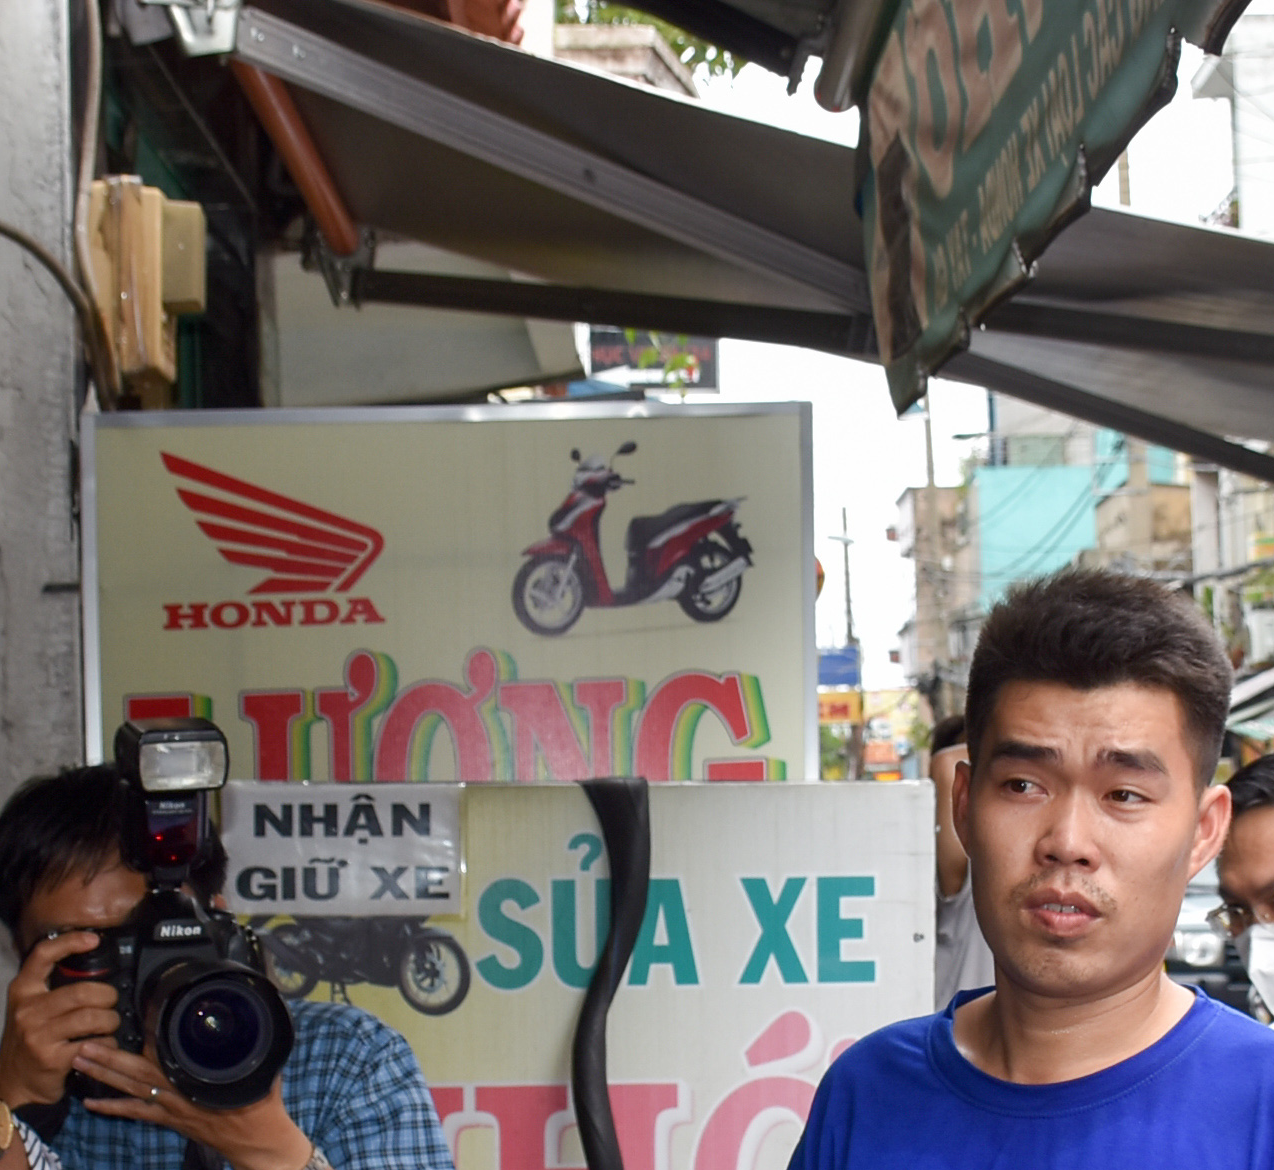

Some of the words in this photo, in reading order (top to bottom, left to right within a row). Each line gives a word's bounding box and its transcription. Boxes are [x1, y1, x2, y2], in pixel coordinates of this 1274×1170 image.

[164, 598, 385, 630] HONDA
[253, 793, 431, 844] NHẬN
[235, 857, 348, 901] GIỮ
[370, 866, 450, 900] XE
[160, 924, 202, 938] Nikon
[738, 876, 876, 983] XE
